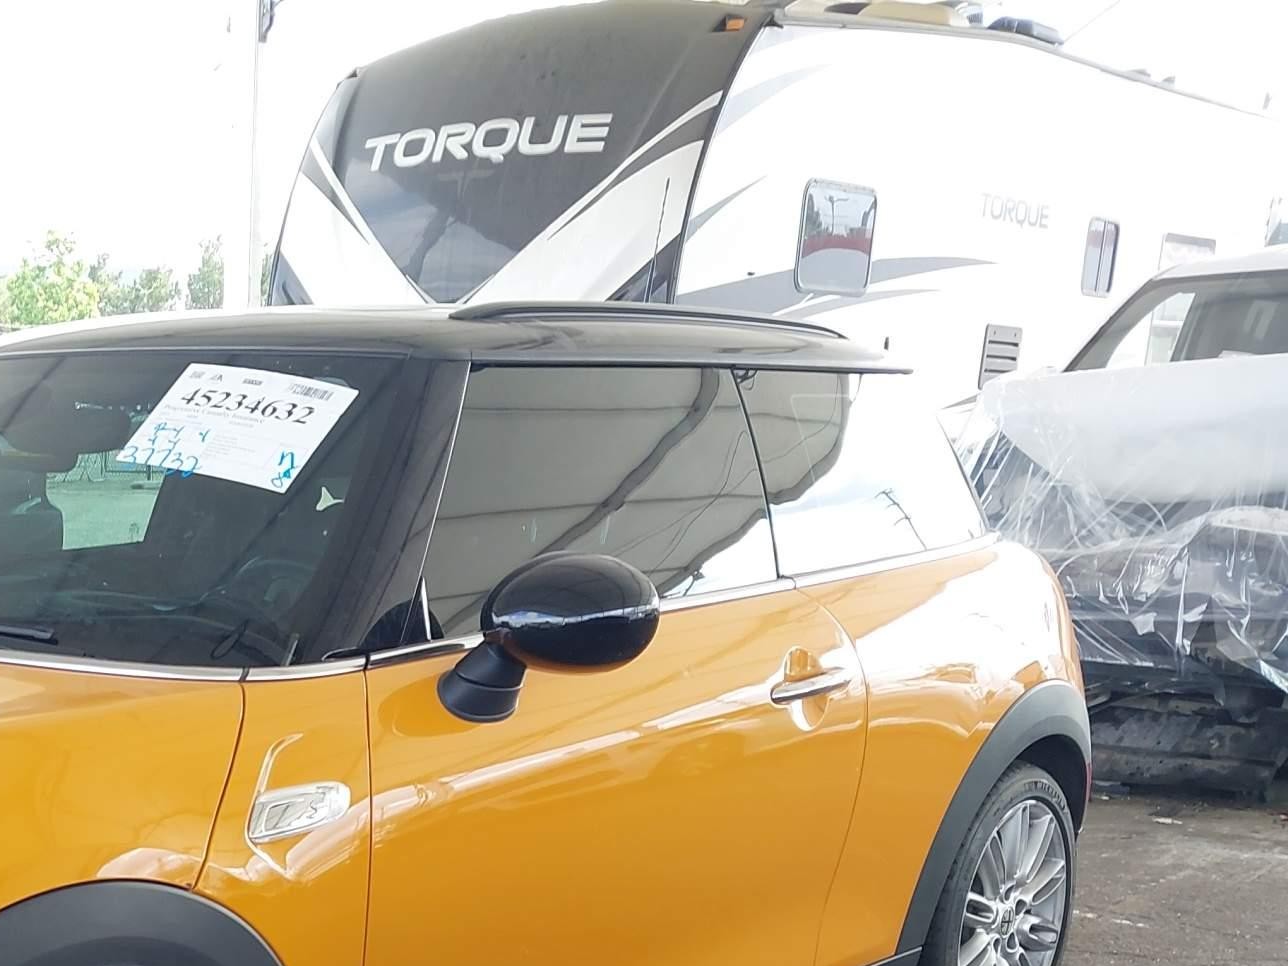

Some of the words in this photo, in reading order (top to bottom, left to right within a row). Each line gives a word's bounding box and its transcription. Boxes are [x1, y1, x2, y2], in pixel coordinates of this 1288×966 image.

[365, 113, 613, 172] TORQUE
[981, 192, 1049, 229] TORQUE
[180, 387, 316, 425] 45234632
